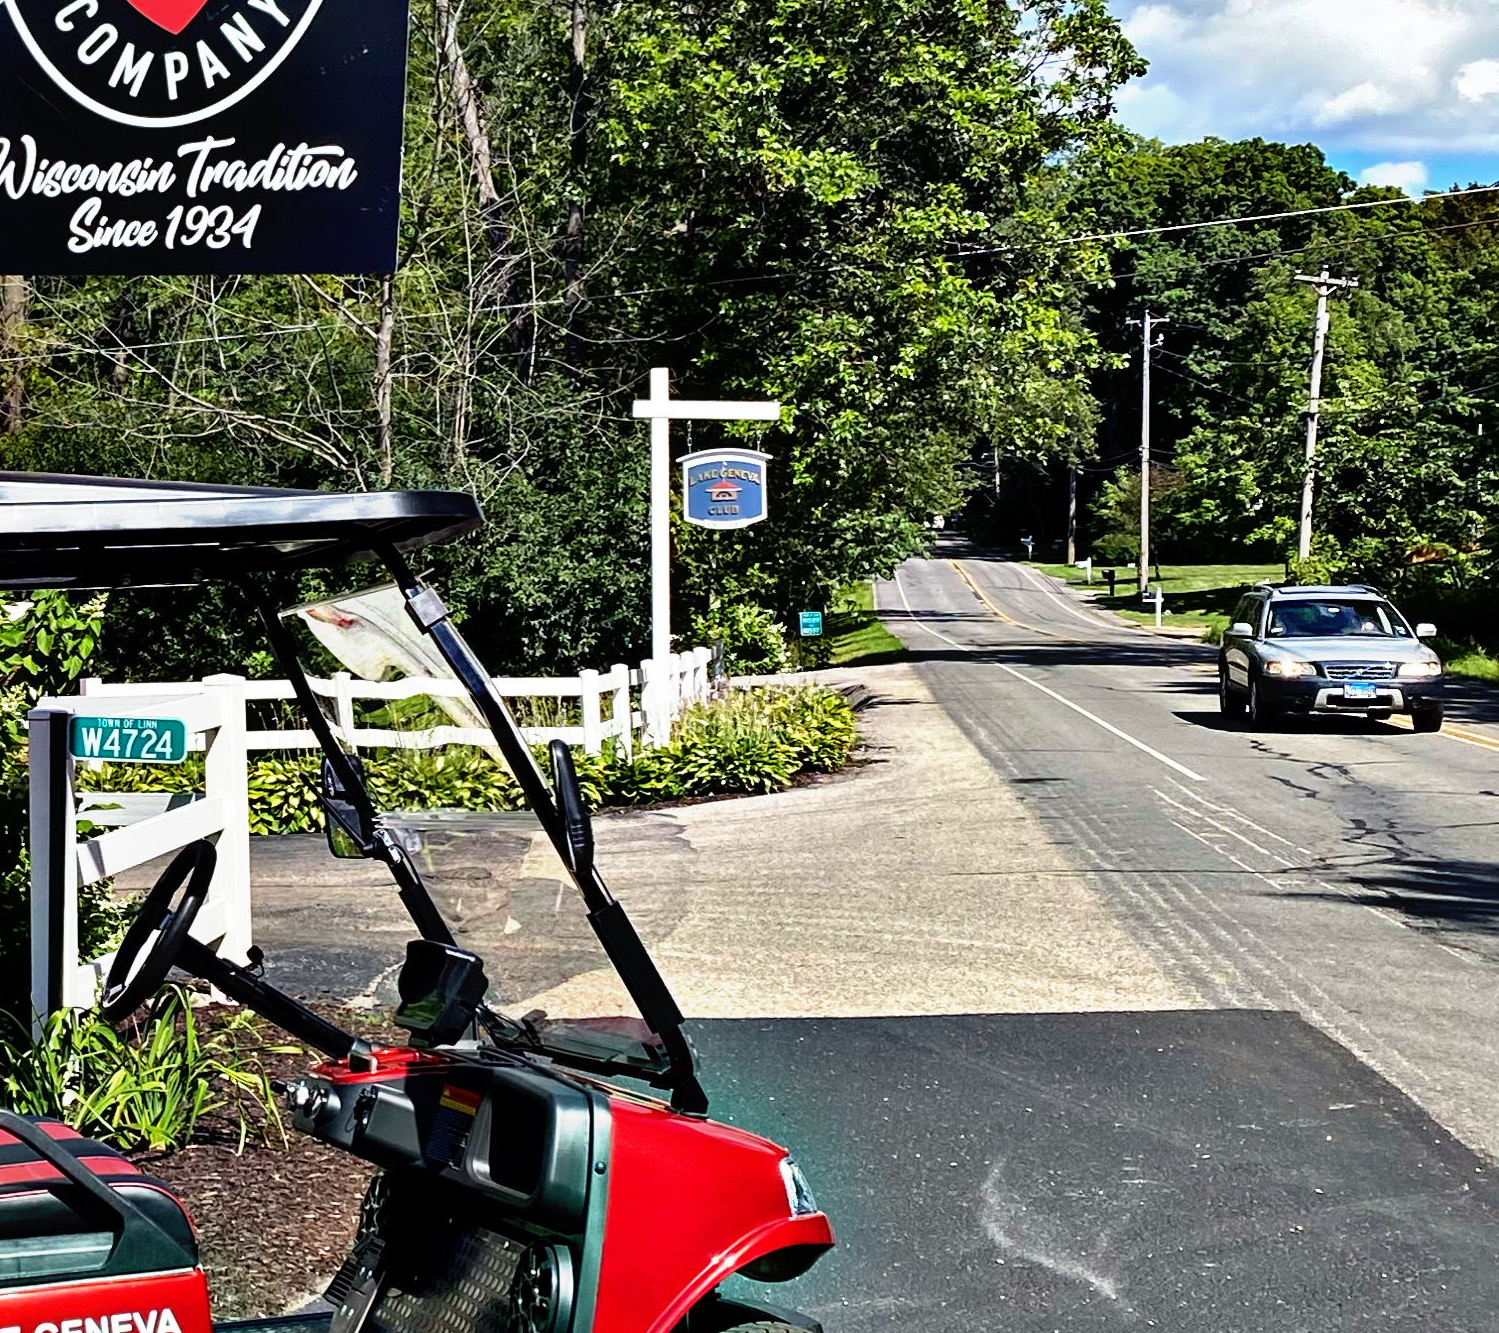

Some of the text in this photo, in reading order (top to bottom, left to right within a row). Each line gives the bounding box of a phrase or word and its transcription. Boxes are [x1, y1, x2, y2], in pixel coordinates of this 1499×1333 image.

[174, 136, 358, 197] Tradition
[67, 197, 261, 254] Since 1934
[721, 469, 760, 485] GENEVA
[709, 505, 739, 516] CLUB
[98, 718, 157, 729] TOWN OF LINN
[82, 728, 173, 759] W4724
